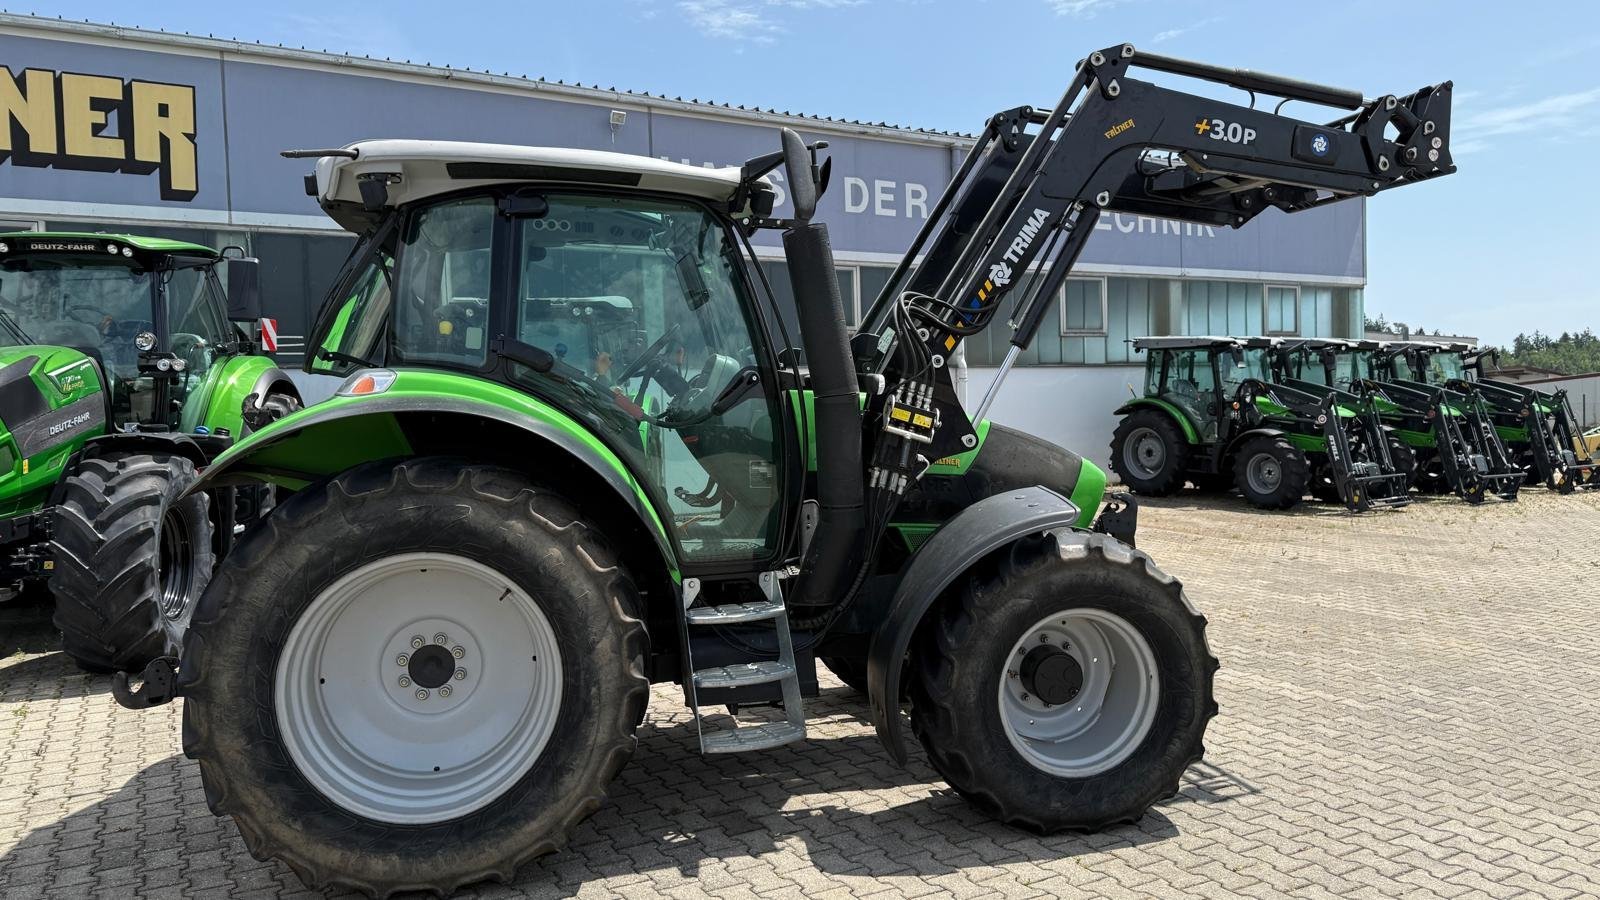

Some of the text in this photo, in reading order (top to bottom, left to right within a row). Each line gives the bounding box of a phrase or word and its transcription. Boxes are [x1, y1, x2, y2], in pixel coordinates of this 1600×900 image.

[1104, 118, 1136, 139] FALTNER
[844, 176, 928, 219] DER
[30, 242, 96, 251] DEUTZ-FAHR
[1002, 208, 1051, 264] TRIMA
[49, 411, 91, 436] DEUTZ-FAHR
